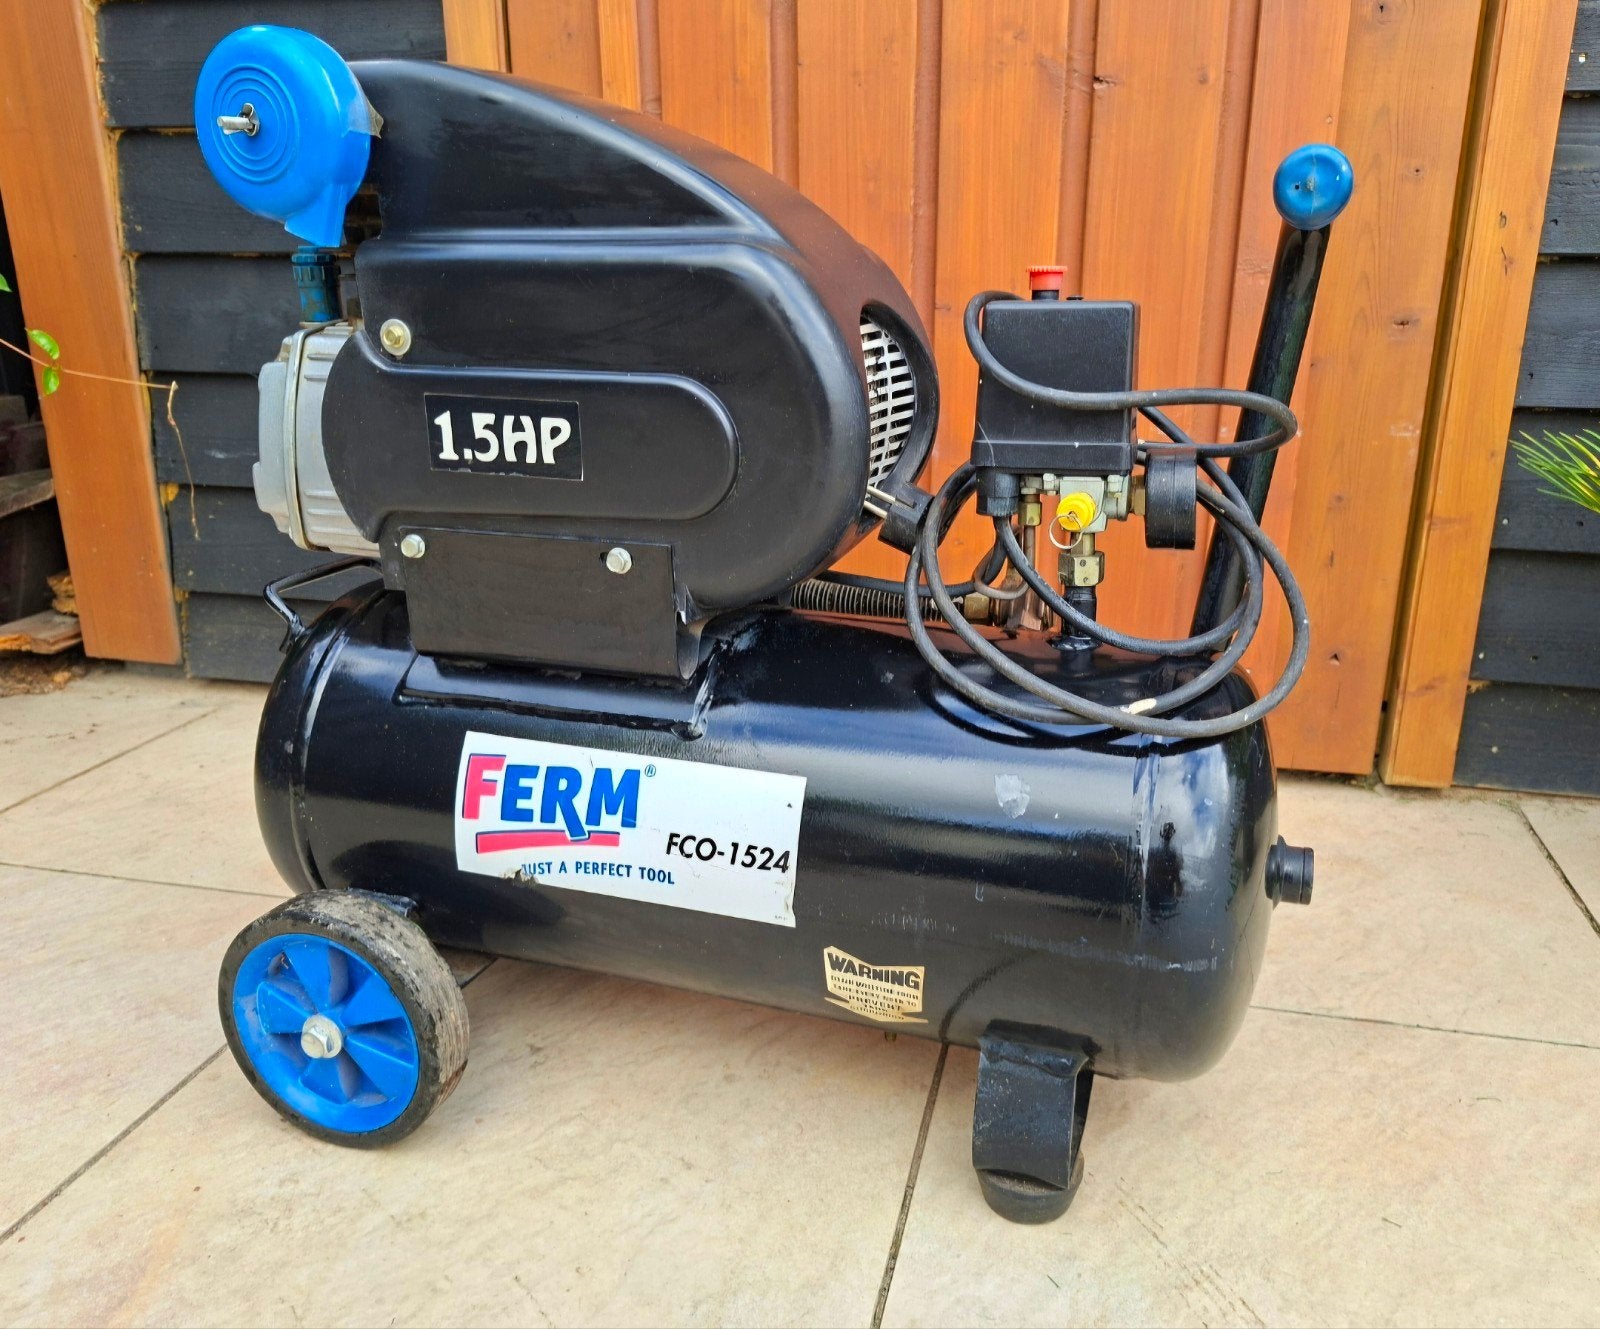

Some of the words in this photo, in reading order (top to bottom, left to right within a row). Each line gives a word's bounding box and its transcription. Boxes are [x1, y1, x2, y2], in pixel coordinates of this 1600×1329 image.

[434, 410, 572, 464] 1.5HP
[462, 753, 641, 839] FERM
[558, 861, 568, 874] A
[575, 861, 632, 877] PERFECT
[639, 866, 675, 885] TOOL
[665, 833, 790, 873] FCO-1524
[827, 952, 921, 991] WARNING
